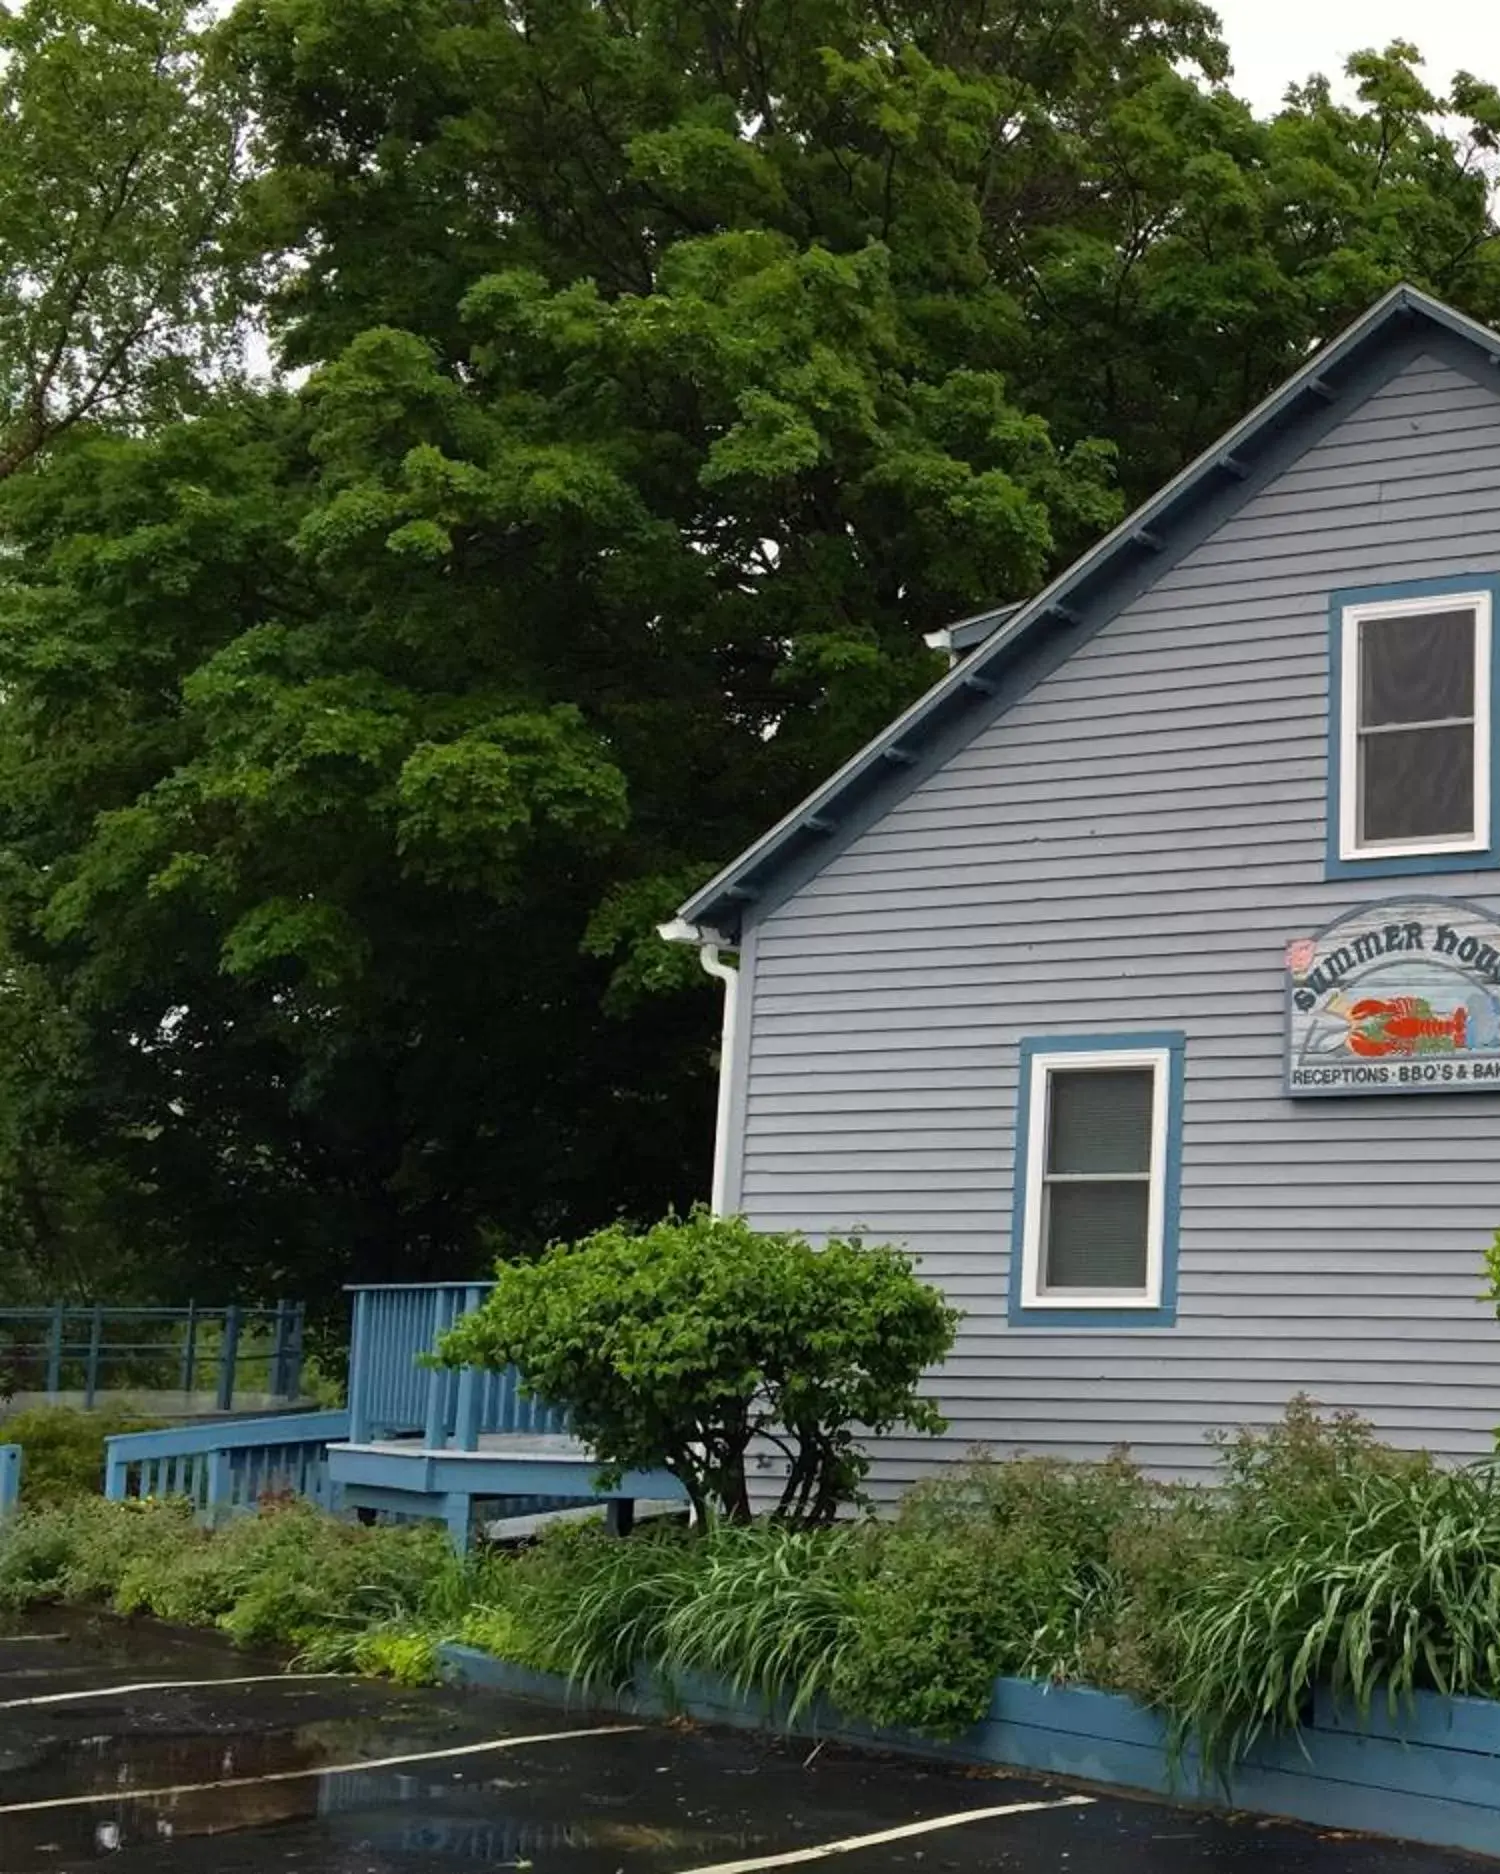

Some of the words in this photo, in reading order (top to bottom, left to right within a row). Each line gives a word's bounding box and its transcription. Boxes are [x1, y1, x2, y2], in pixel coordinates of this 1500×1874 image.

[1293, 921, 1426, 1011] SUMMER
[1293, 1066, 1390, 1085] RECEPTIONS
[1456, 1064, 1468, 1080] &
